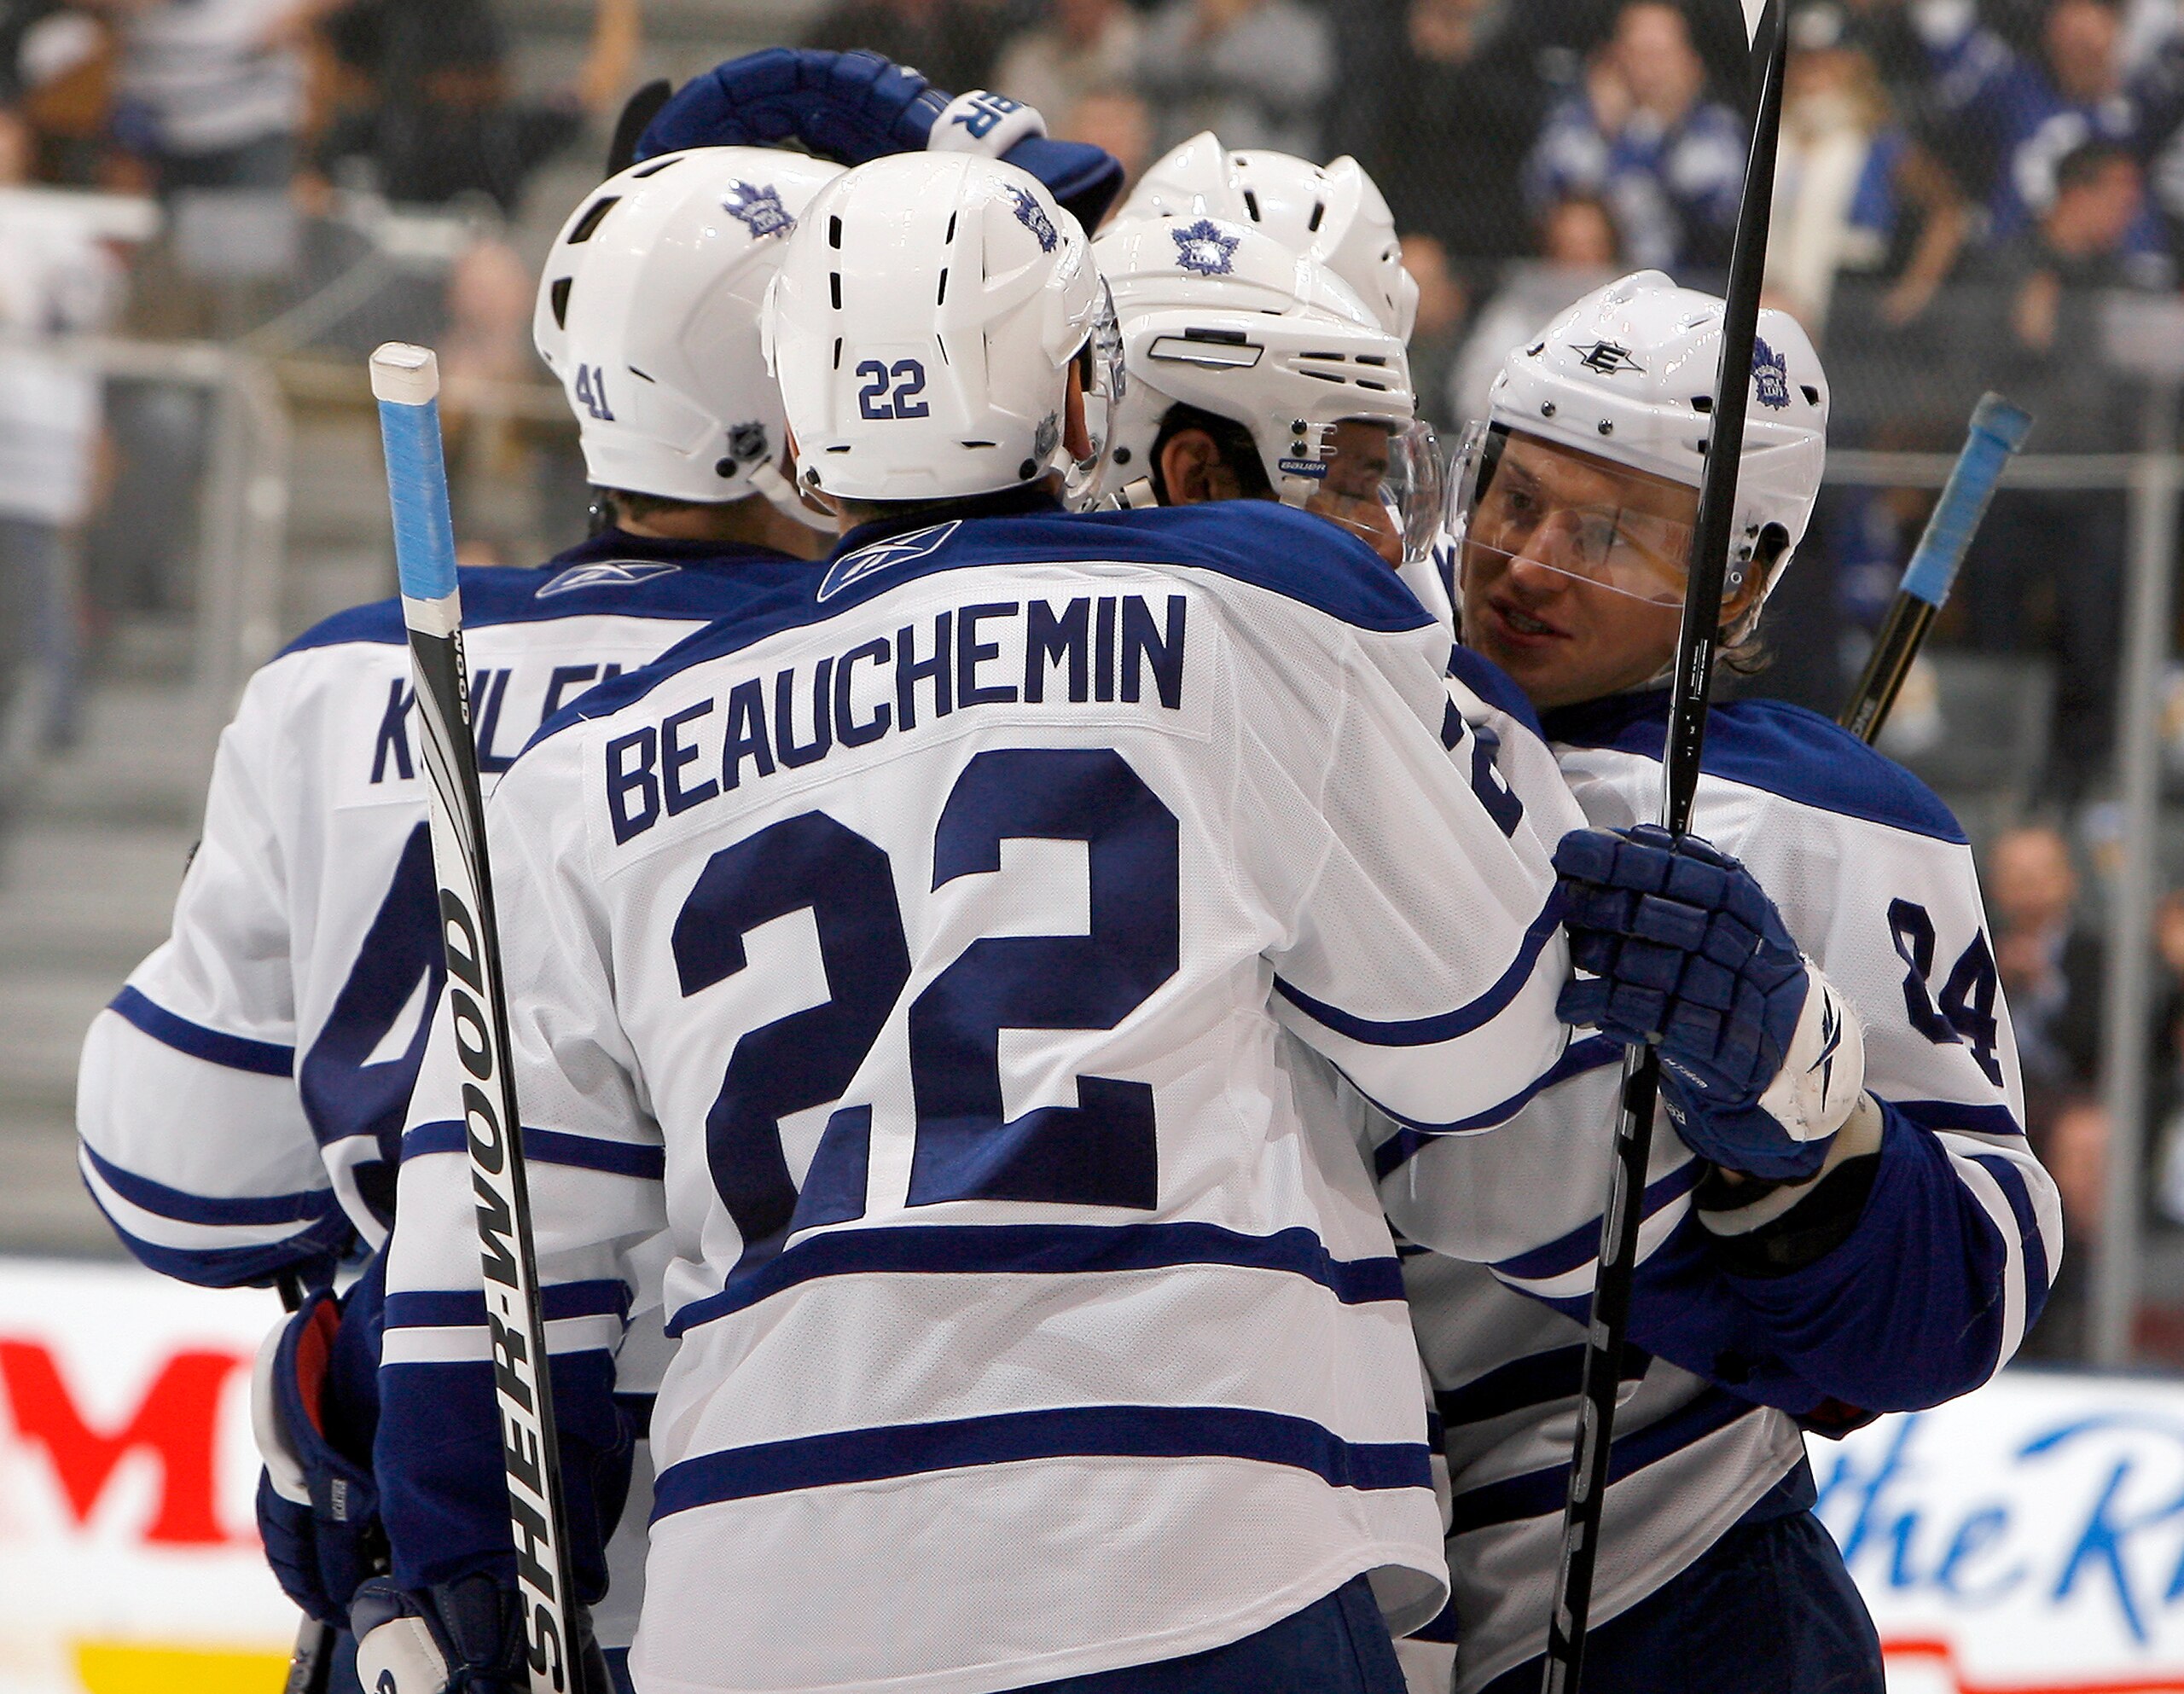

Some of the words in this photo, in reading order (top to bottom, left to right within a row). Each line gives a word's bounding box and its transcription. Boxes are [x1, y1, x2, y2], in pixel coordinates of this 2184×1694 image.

[576, 363, 615, 422] 41
[856, 358, 929, 420] 22
[453, 629, 470, 725] WOOD
[606, 595, 1187, 846] BEAUCHEMIN
[671, 747, 1181, 1291] 22
[1886, 897, 2004, 1088] 24
[439, 887, 565, 1694] SHER-WOOD
